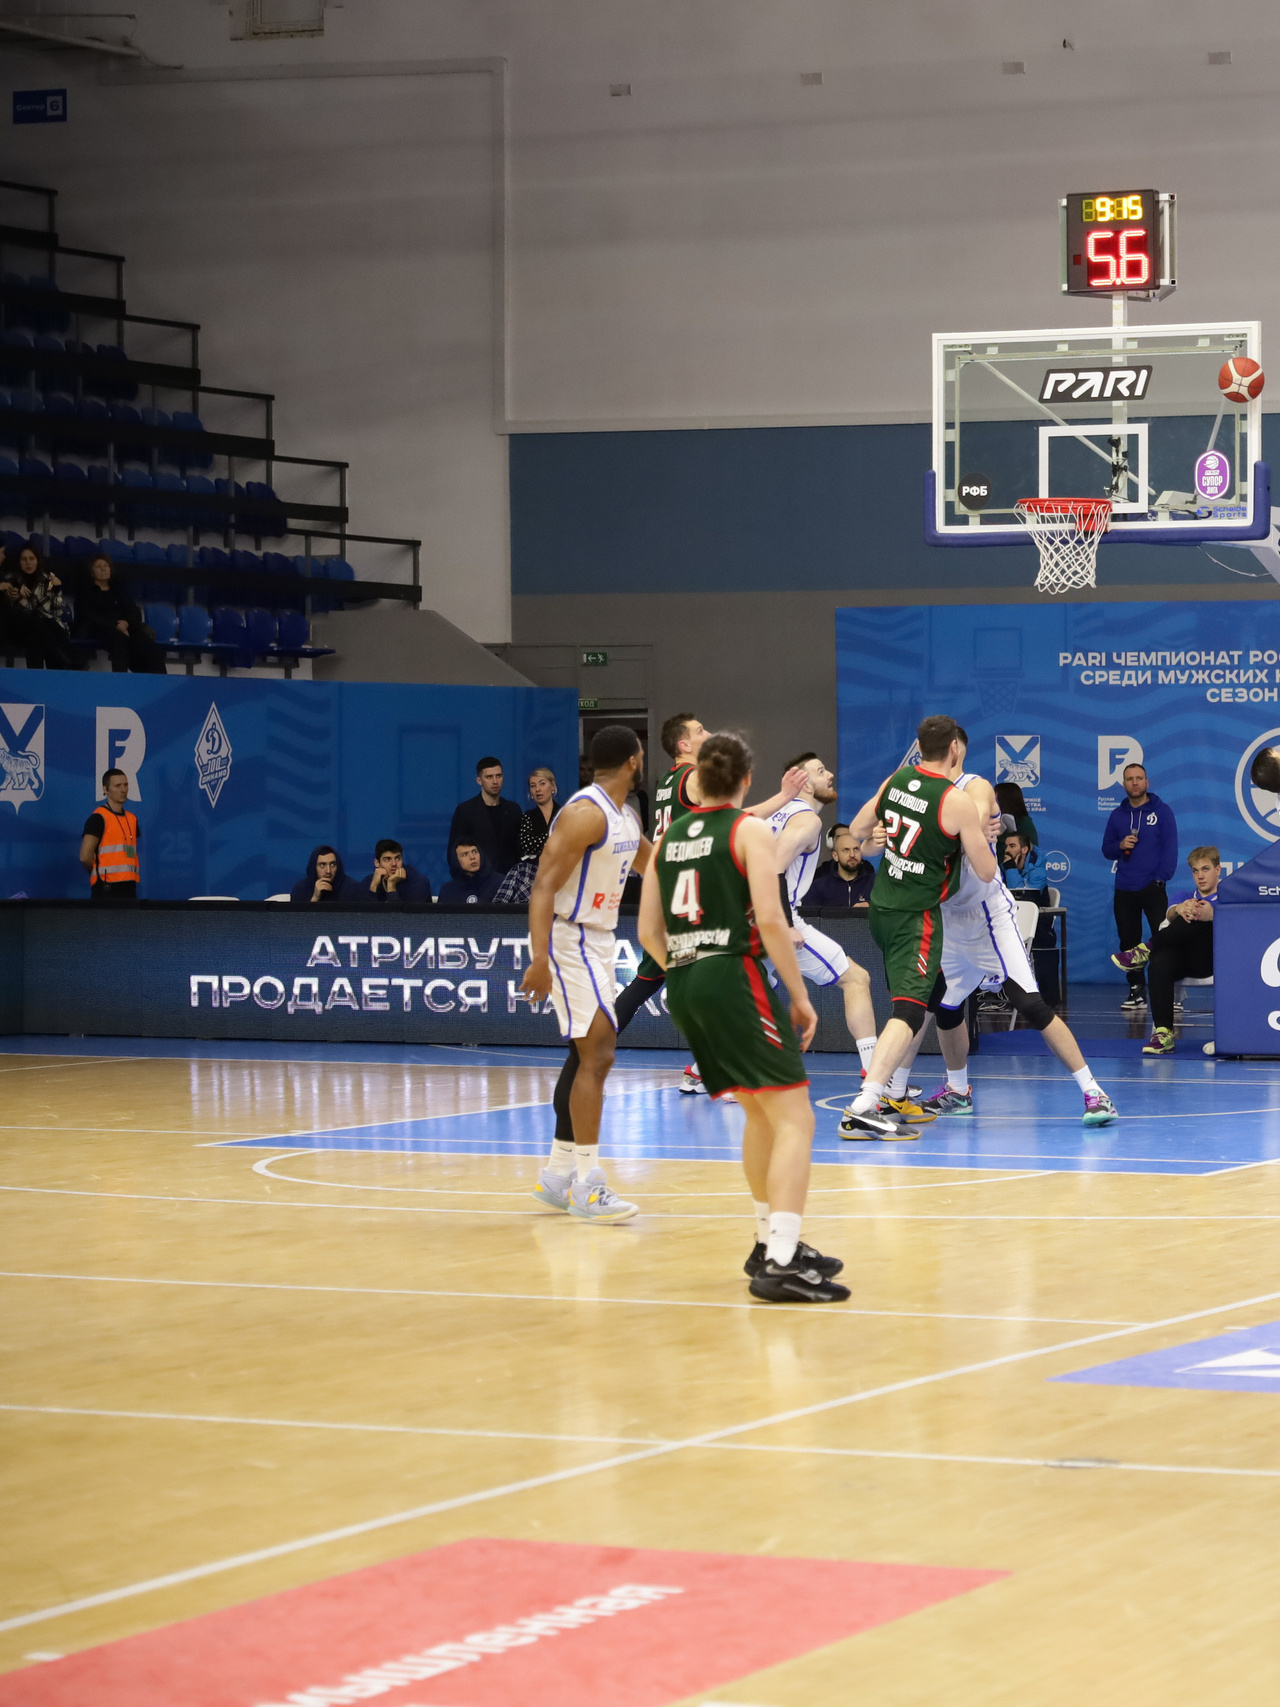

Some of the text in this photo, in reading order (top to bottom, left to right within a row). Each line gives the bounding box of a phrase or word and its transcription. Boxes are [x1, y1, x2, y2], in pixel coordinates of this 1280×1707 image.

[50, 99, 60, 112] 6
[1095, 196, 1142, 221] 9:15
[1042, 368, 1149, 401] PARI
[962, 485, 987, 498] РФБ
[1059, 652, 1106, 667] PARI
[1112, 650, 1243, 667] ЧЕМПИОНАТ
[1080, 670, 1152, 687] СРЕДИ
[1158, 669, 1269, 685] МУЖСКИХ
[1206, 687, 1279, 703] СЕЗОН
[887, 787, 929, 814] ШУХОВЦОВ
[884, 809, 923, 858] 27
[1045, 861, 1067, 871] РФБ
[671, 868, 704, 926] 4
[306, 936, 640, 970] АТРИБУТА
[189, 975, 489, 1015] ПРОДАЕТСЯ
